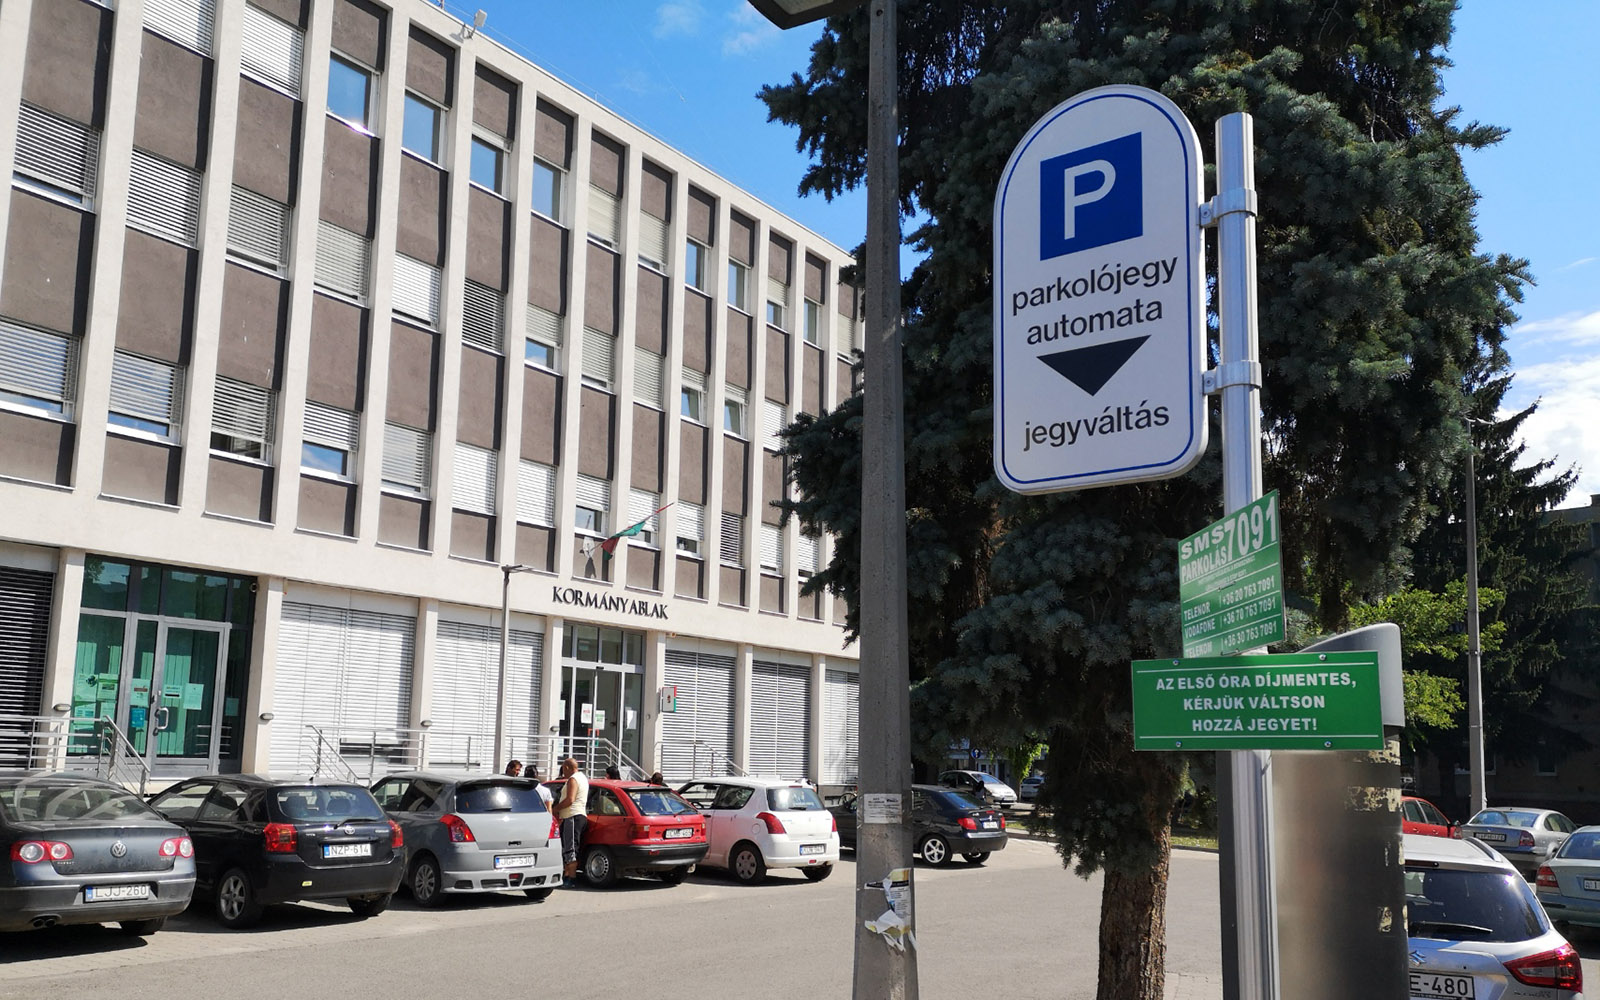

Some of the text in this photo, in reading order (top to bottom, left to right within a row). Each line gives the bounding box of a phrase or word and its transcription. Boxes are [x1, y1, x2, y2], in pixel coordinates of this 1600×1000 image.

[1064, 159, 1116, 240] P
[1012, 257, 1178, 316] parkolójegy
[1027, 299, 1163, 345] automata
[1024, 400, 1170, 452] jegyváltás
[1181, 525, 1224, 560] SMS
[1224, 496, 1277, 562] 7091
[1181, 544, 1226, 584] PARKOLÁS
[553, 586, 669, 620] KORMÁNYABLAK
[1184, 602, 1211, 621] TELENOR
[1257, 575, 1275, 593] 7091
[1185, 618, 1216, 639] VODAFONE
[1259, 596, 1276, 613] 7091
[1260, 620, 1277, 637] 7091
[1156, 671, 1357, 691] AZ ELSŐ ÓRA DÍJMENTES,
[1184, 693, 1325, 711] KÉRJÜK VÁLTSON
[1192, 716, 1317, 732] HOZZÁ JEGYET!
[331, 845, 369, 857] NZP-614
[95, 885, 147, 898] LJJ-260
